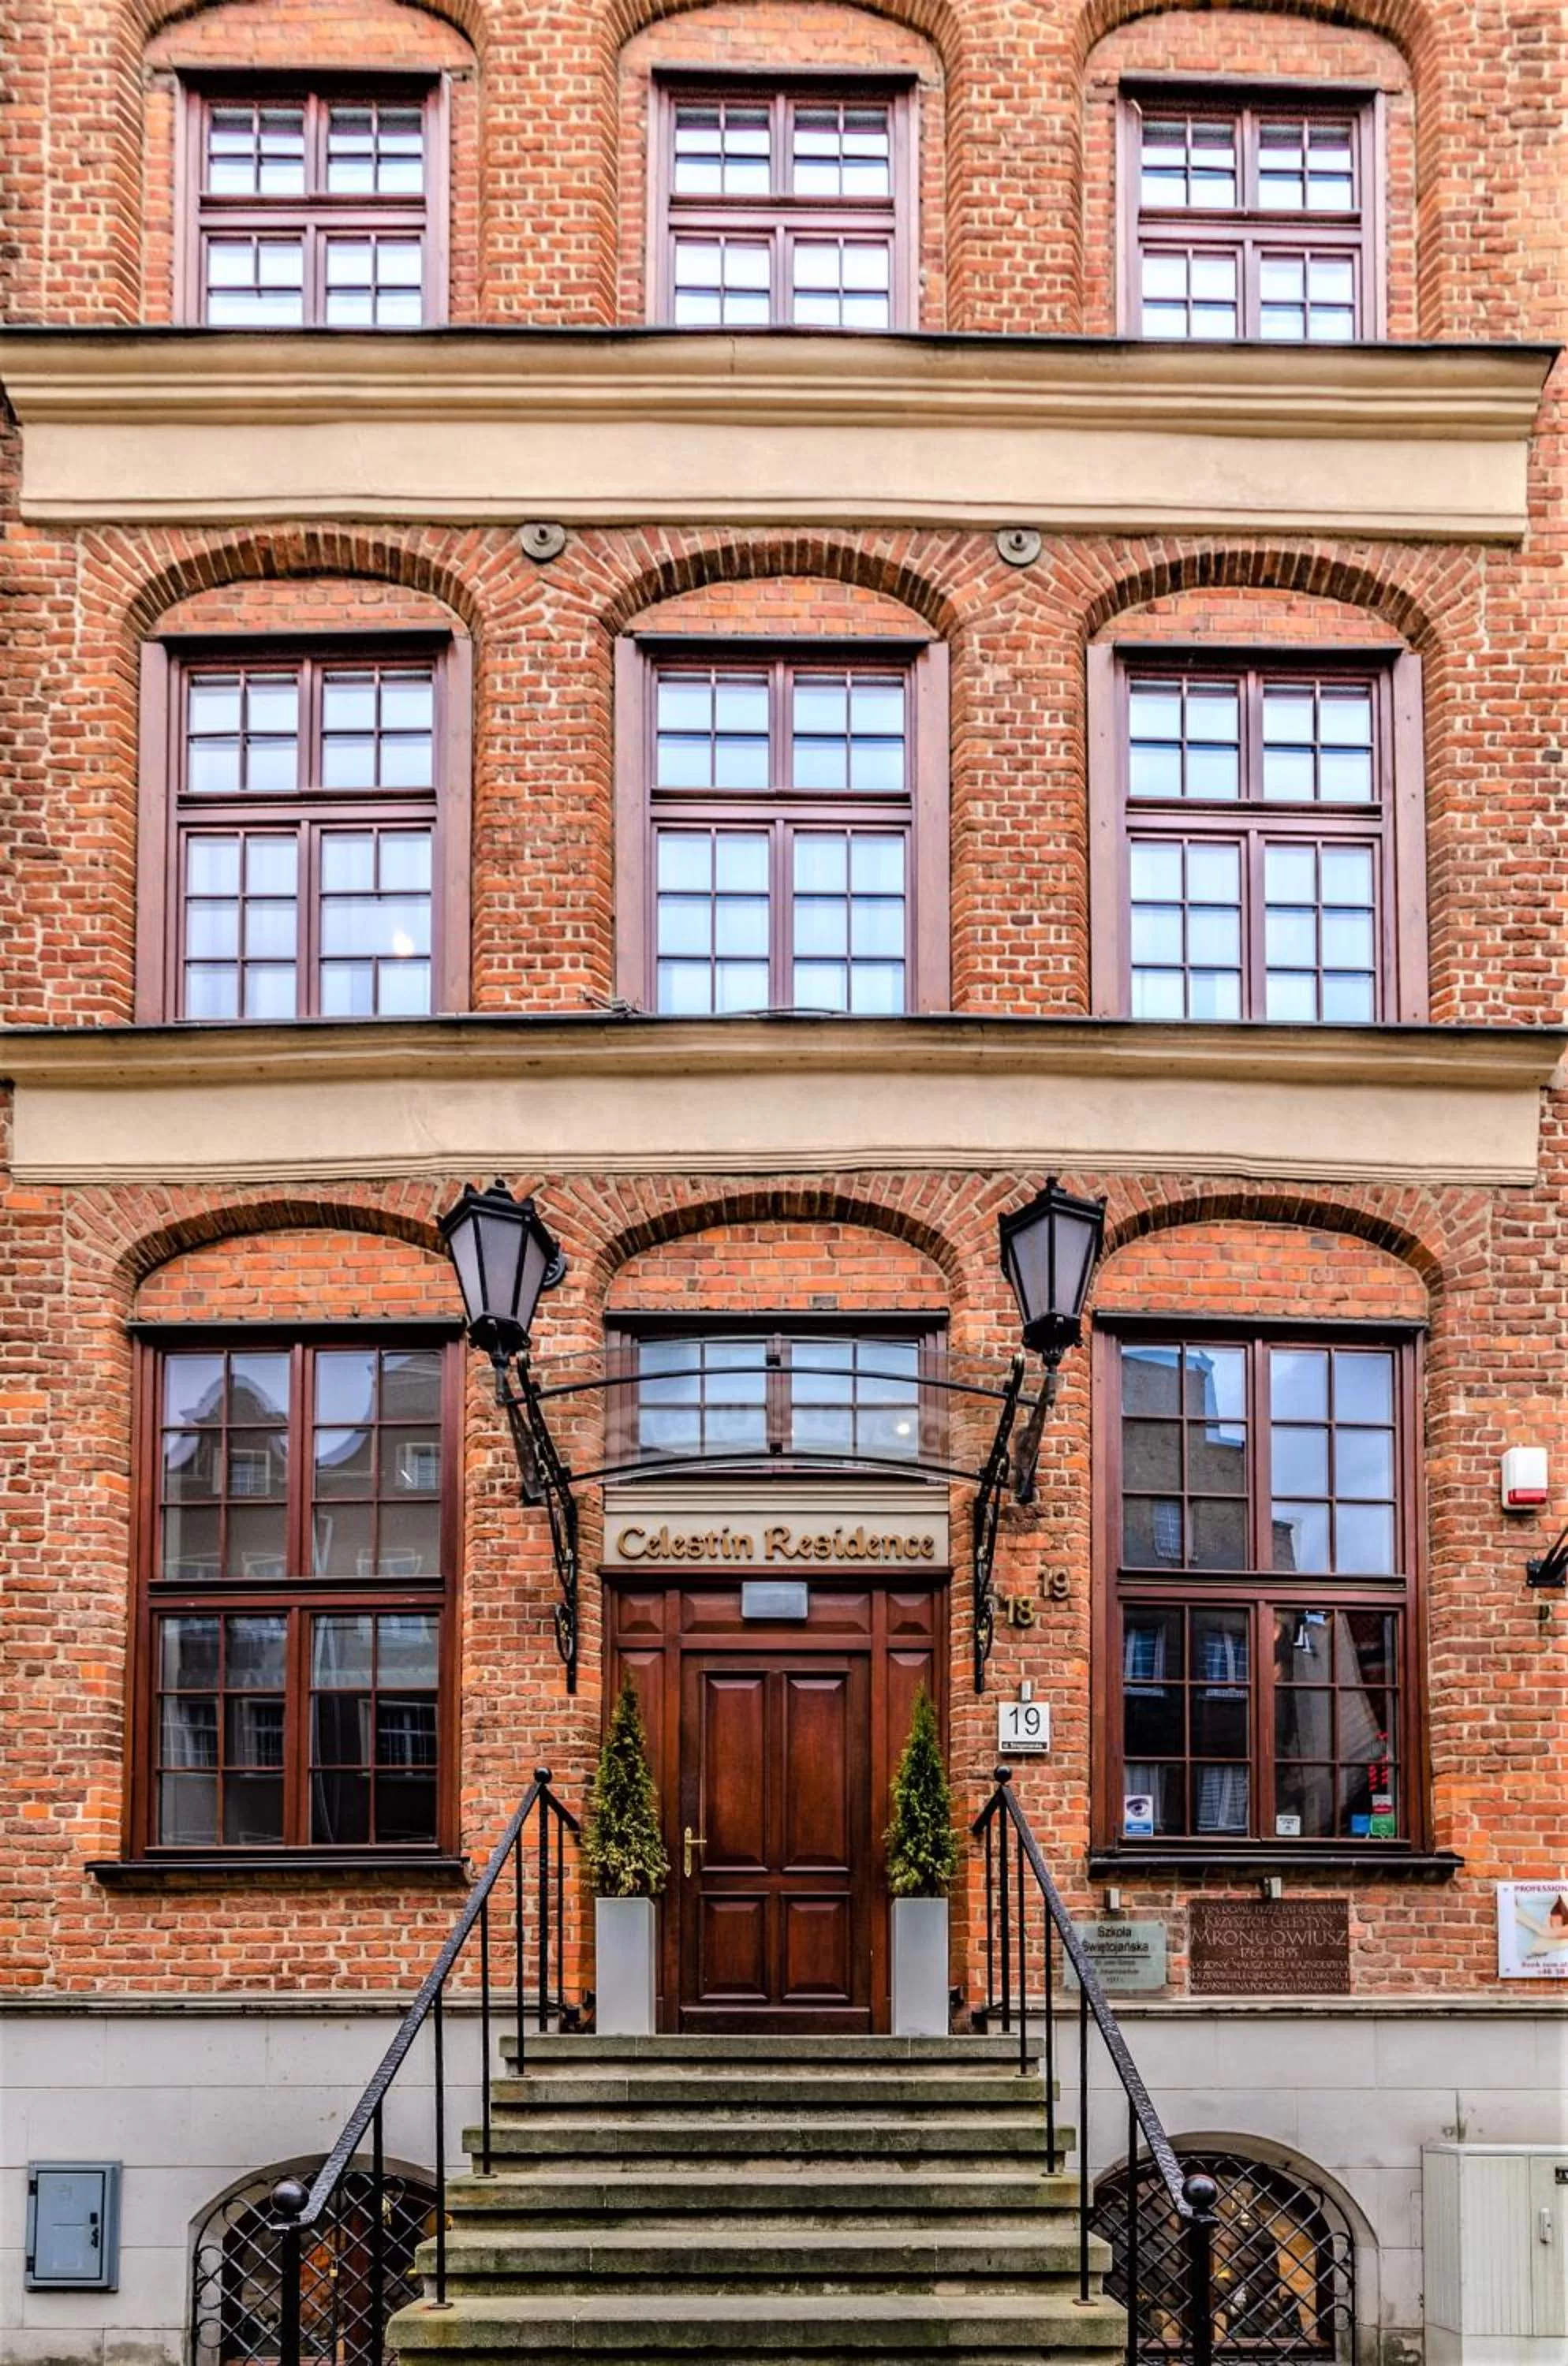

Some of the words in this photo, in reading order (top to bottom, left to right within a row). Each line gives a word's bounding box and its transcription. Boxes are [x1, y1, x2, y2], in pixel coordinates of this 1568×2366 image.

[618, 1525, 754, 1560] Celestin
[763, 1525, 935, 1560] Residence
[1038, 1565, 1070, 1599] 19
[1005, 1594, 1035, 1625] 18
[1009, 1707, 1040, 1736] 19
[1192, 1929, 1346, 1946] MRONGOWIUSZ
